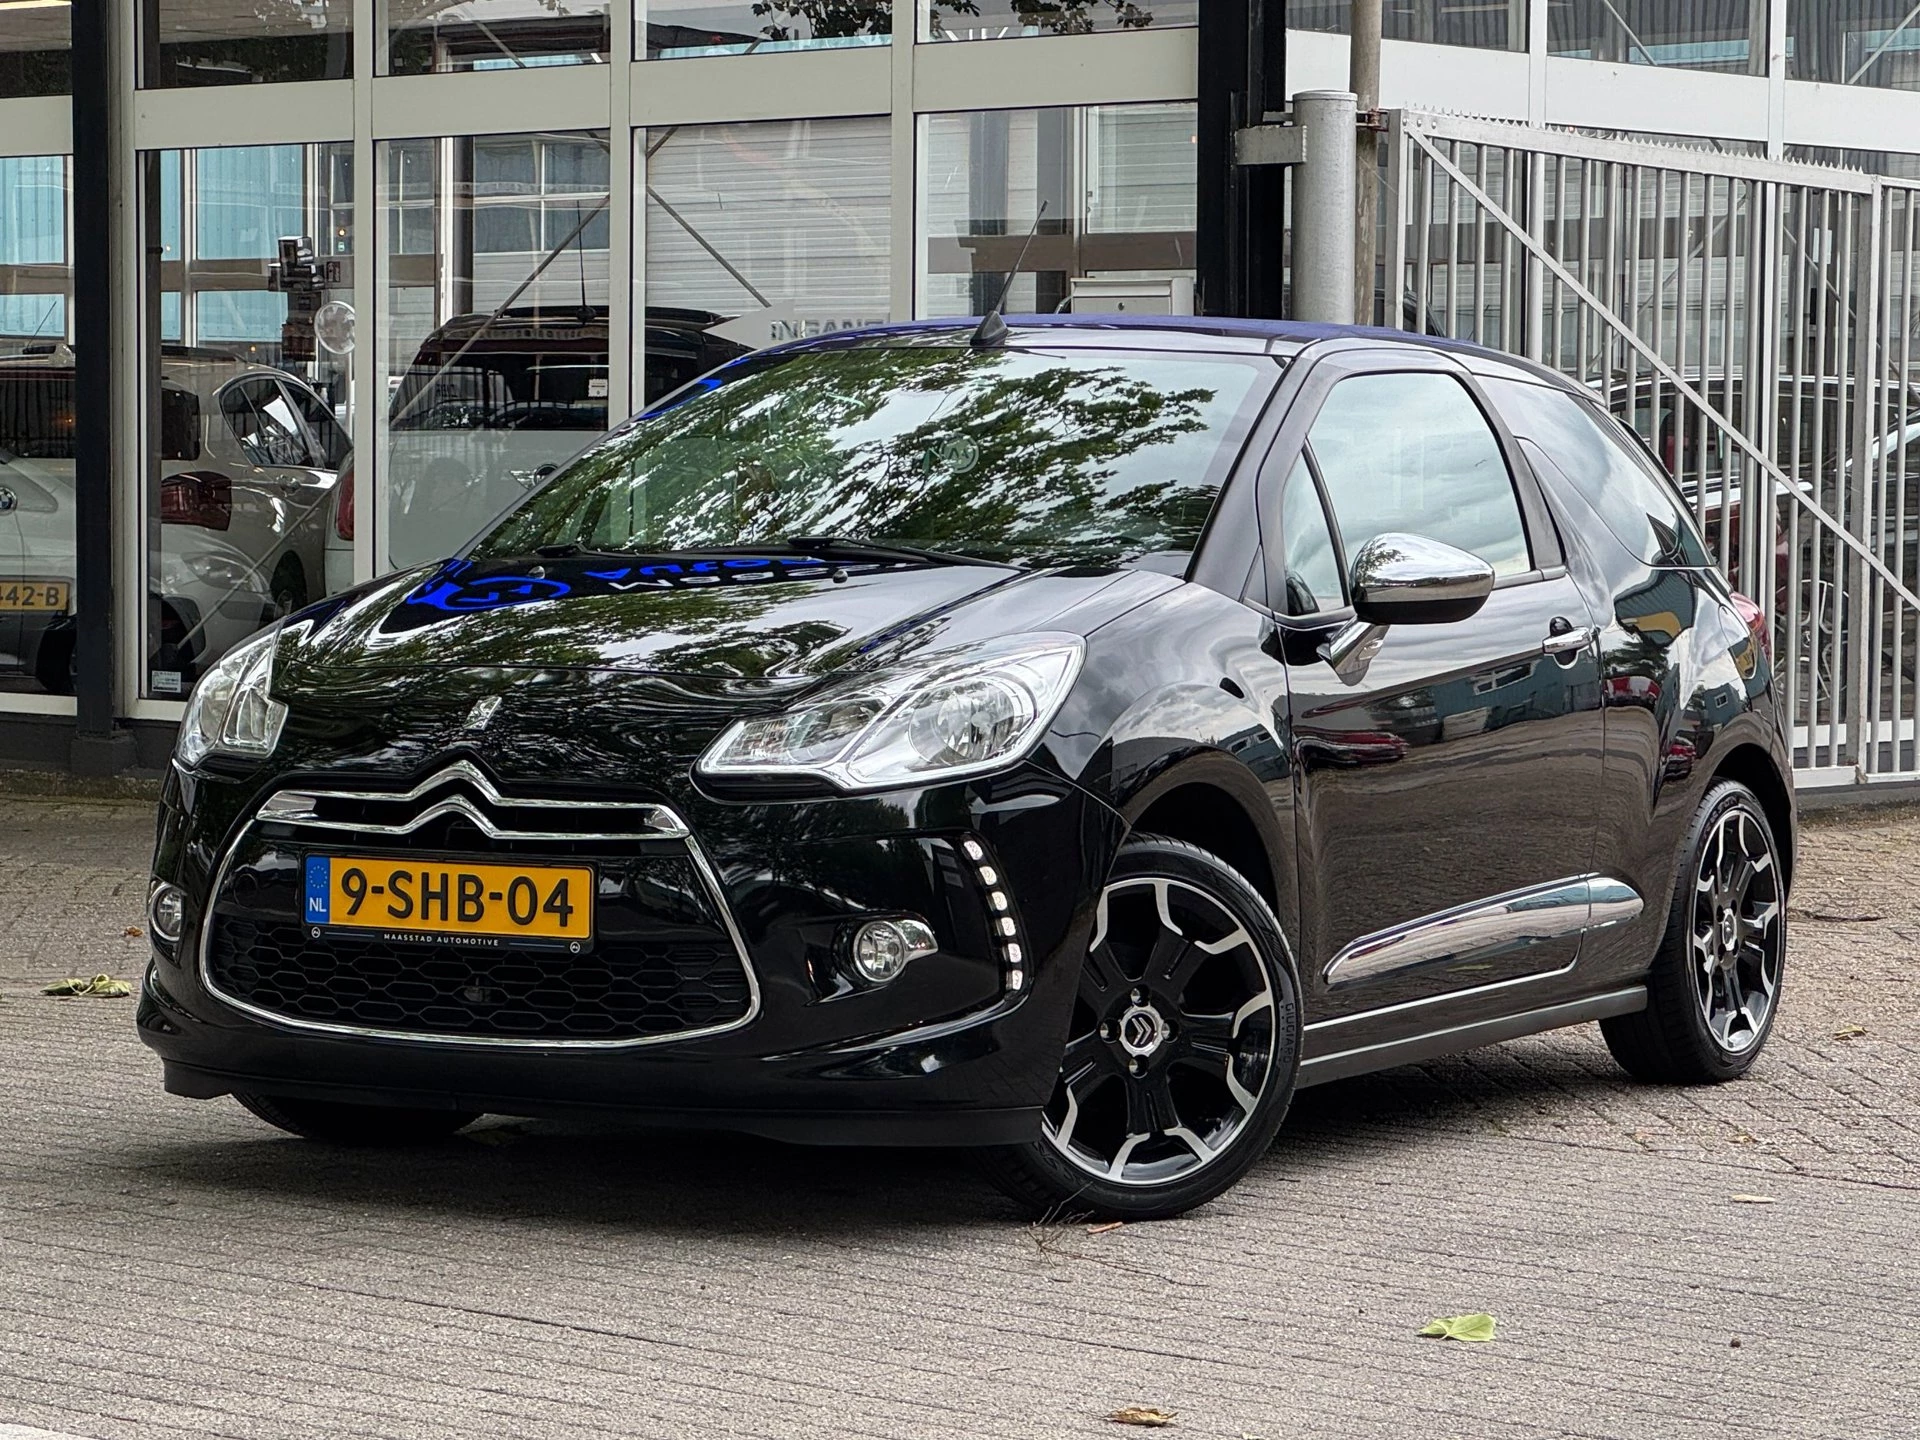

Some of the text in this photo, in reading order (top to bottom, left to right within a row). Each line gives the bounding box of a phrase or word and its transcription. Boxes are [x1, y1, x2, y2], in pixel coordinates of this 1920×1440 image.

[0, 585, 60, 607] 42-B
[308, 897, 328, 914] NL
[340, 867, 574, 928] 9-SHB-04
[383, 933, 499, 947] MAASSTAD AUTOMOTIVE
